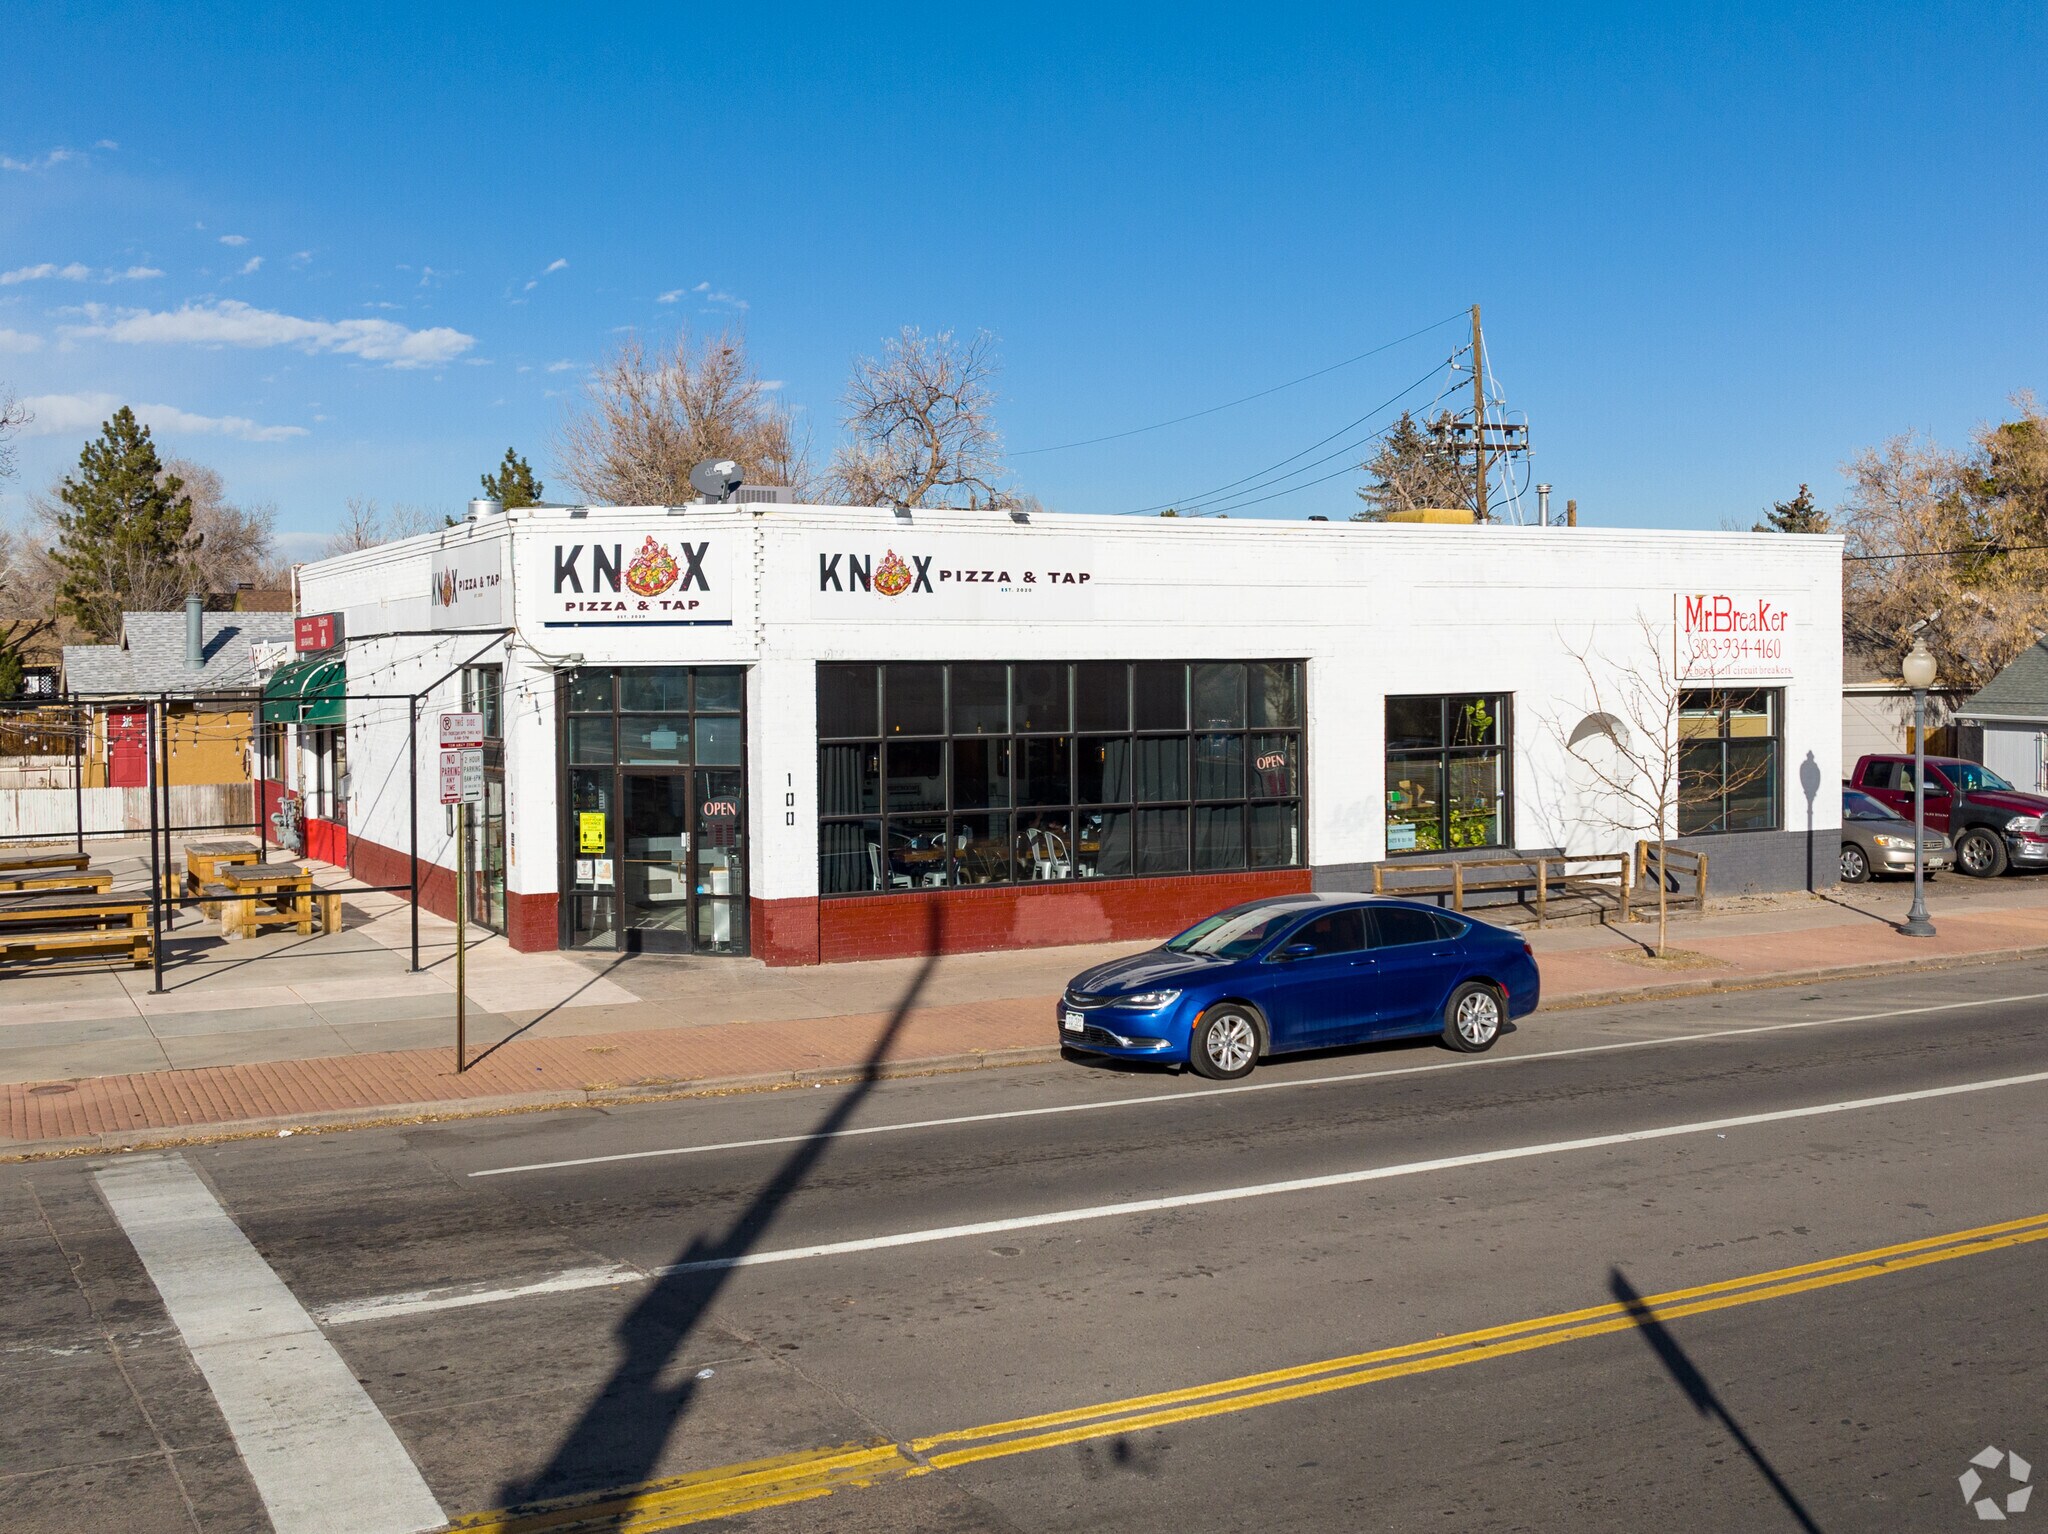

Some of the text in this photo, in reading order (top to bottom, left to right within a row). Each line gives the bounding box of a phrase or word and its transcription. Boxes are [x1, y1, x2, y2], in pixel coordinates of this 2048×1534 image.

[940, 570, 1012, 583] PIZZA
[1023, 571, 1037, 583] &
[1048, 572, 1091, 584] TAP
[459, 578, 477, 591] PIZZA
[480, 576, 484, 588] &
[486, 574, 499, 587] TAP
[565, 601, 700, 611] PIZZA & TAP
[1693, 638, 1781, 659] 303-934-4160
[1733, 665, 1758, 675] circuit
[455, 718, 476, 727] THIS SIDE
[446, 755, 455, 764] NO
[469, 755, 480, 763] HOUR
[1256, 754, 1285, 770] OPEN
[441, 766, 460, 776] PARKING
[463, 765, 481, 773] PARKING
[786, 773, 794, 826] 100
[703, 802, 736, 816] OPEN
